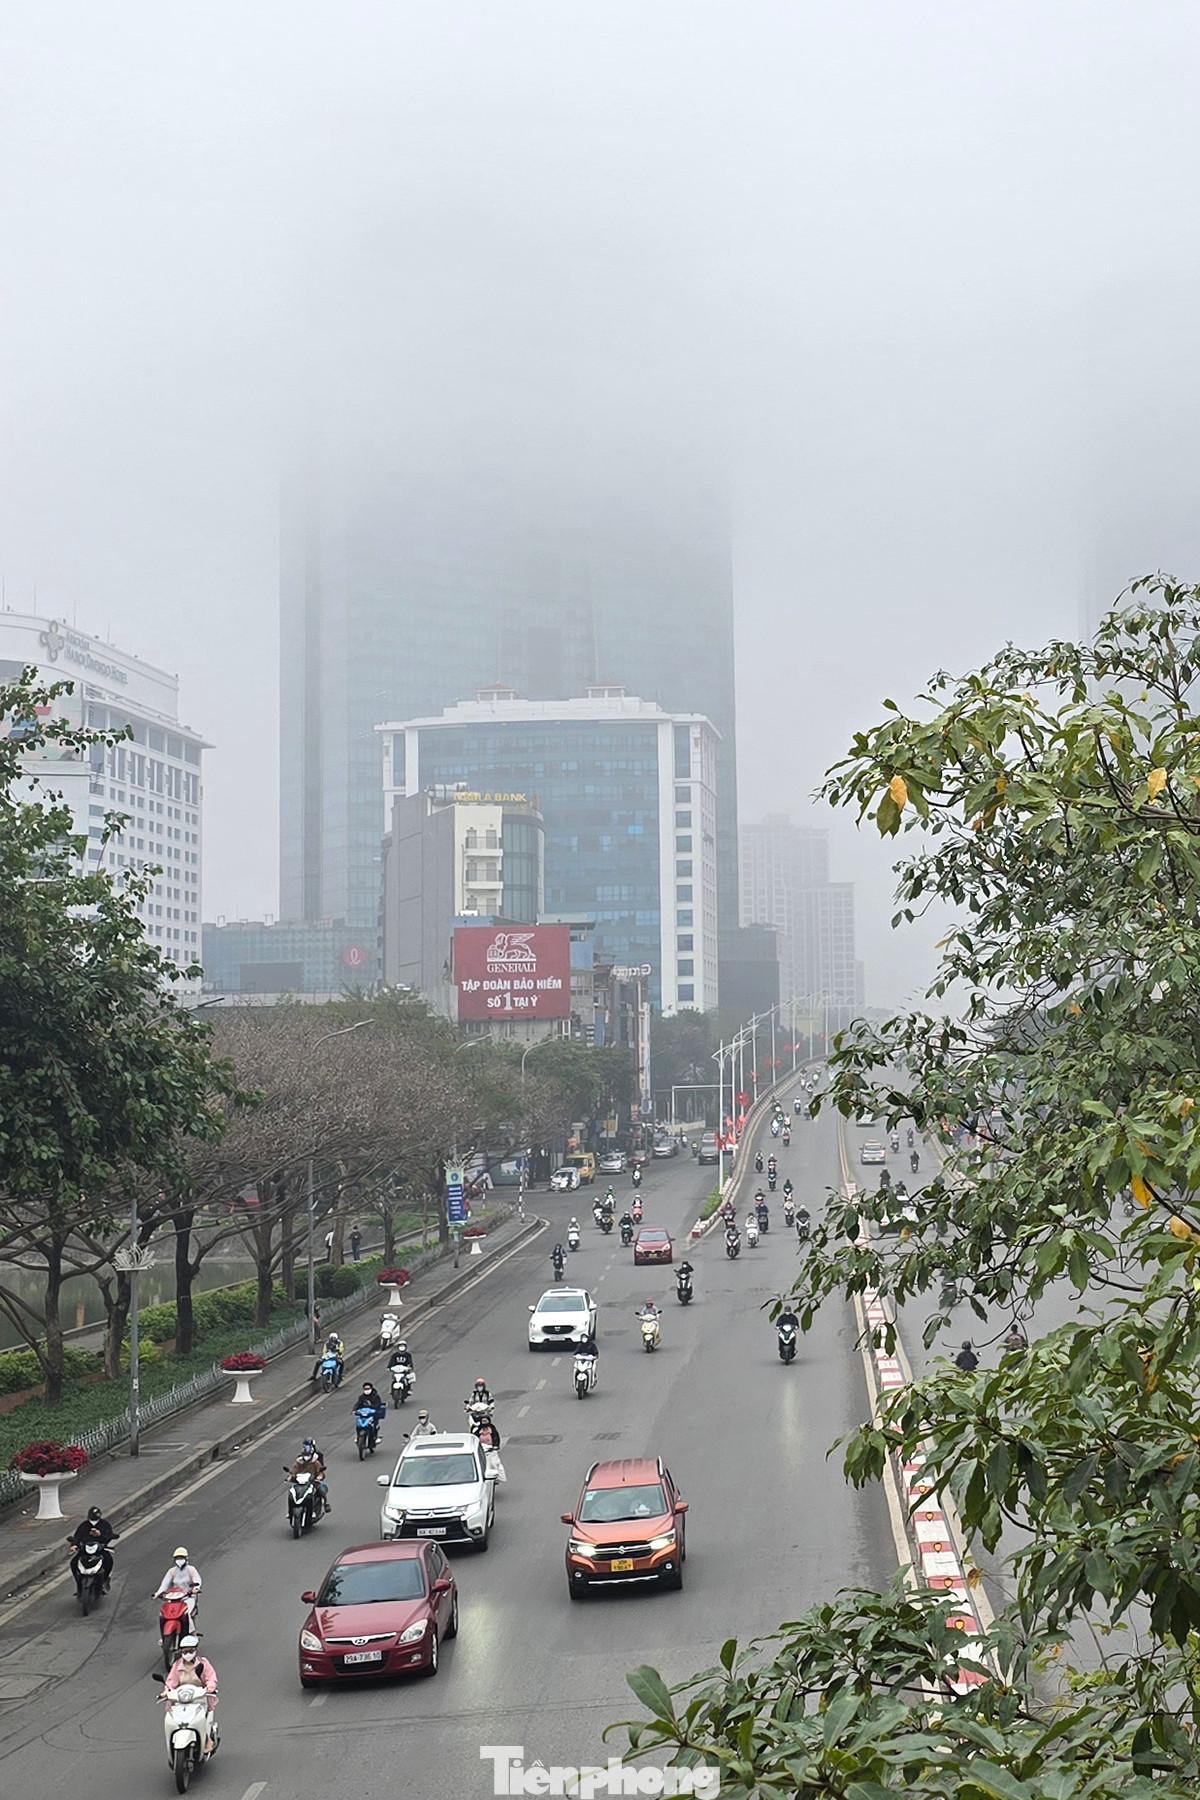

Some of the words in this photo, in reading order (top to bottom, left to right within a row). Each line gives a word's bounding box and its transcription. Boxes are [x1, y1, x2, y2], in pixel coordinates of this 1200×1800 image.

[494, 793, 527, 802] BANK
[486, 963, 536, 973] GENERALI
[461, 979, 481, 993] TẬP
[483, 979, 511, 990] ĐOÀN
[513, 977, 534, 990] BẢO
[487, 995, 502, 1008] SỐ
[503, 992, 513, 1010] 1
[513, 997, 529, 1009] TẠI
